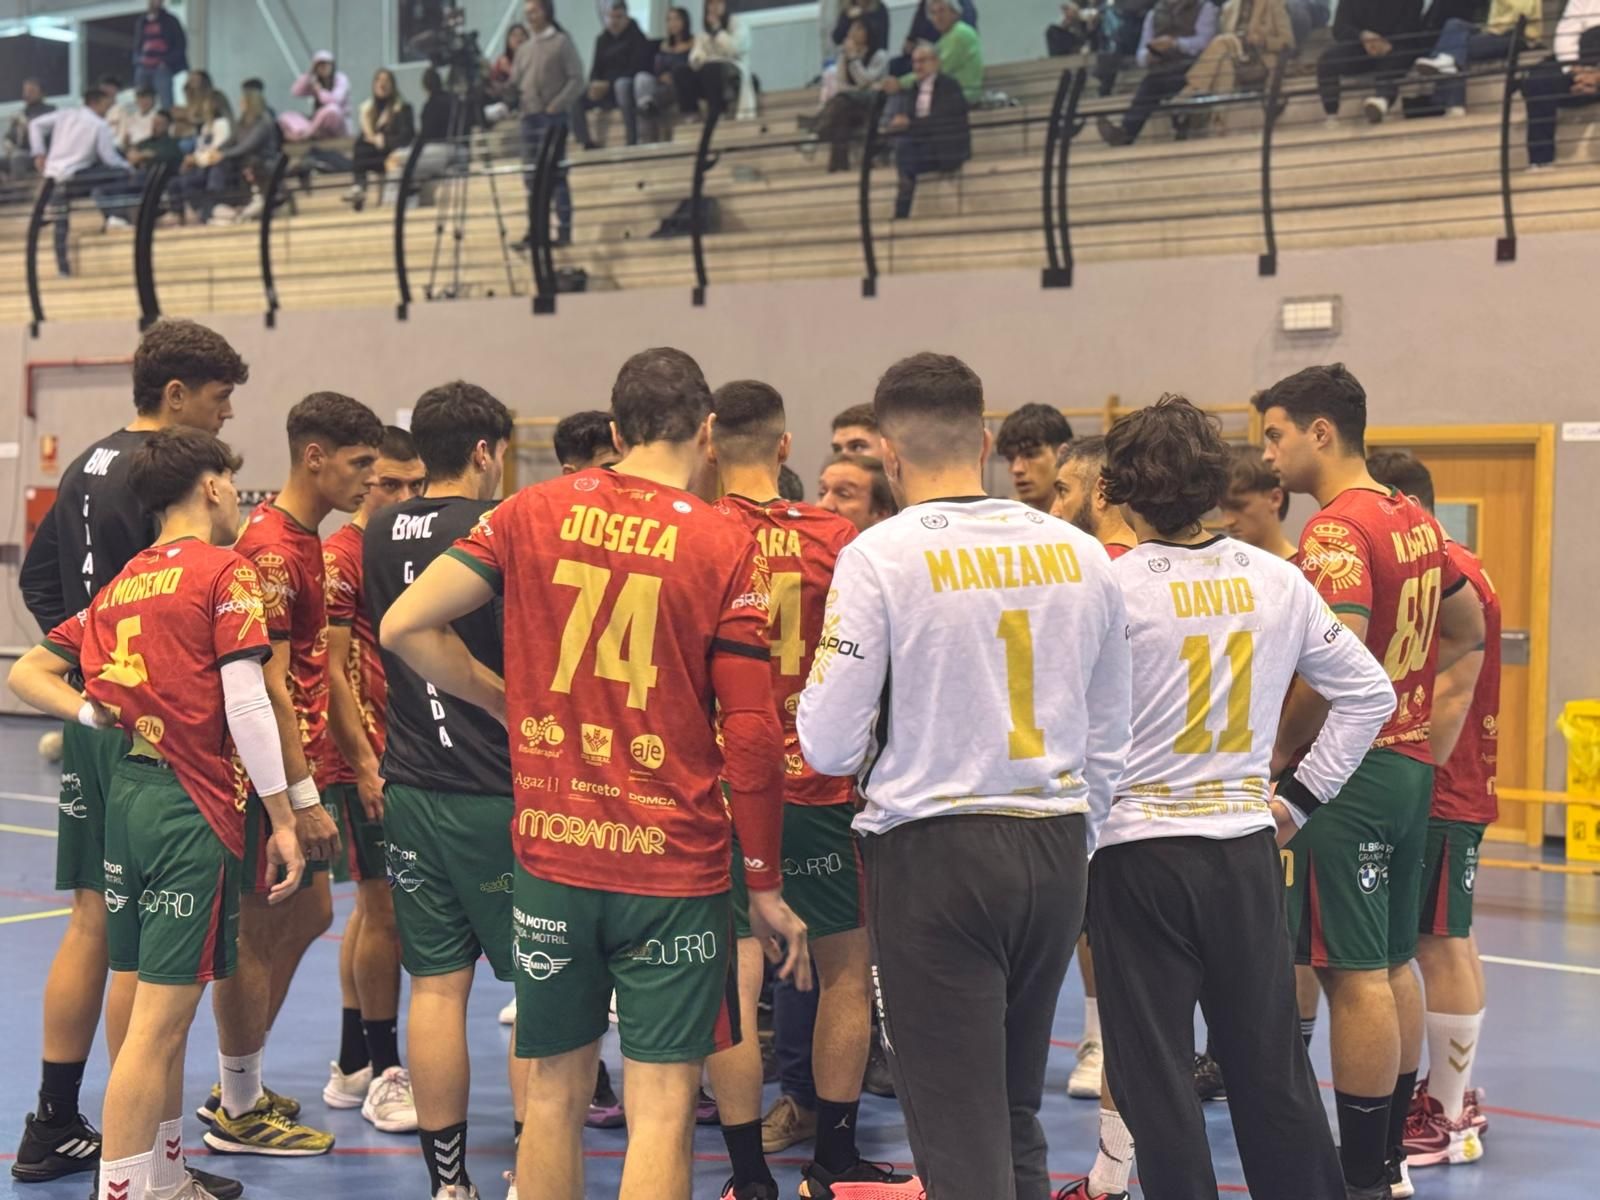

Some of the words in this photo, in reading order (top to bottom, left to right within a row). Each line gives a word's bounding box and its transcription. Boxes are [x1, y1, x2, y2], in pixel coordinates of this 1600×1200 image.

[392, 512, 438, 540] BMC
[559, 504, 679, 561] JOSECA
[924, 543, 1082, 593] MANZANO
[1168, 577, 1255, 618] DAVID
[549, 558, 663, 711] 74
[1382, 567, 1441, 682] 80
[996, 609, 1046, 761] 1
[1172, 630, 1255, 755] 11
[136, 717, 162, 740] aje
[632, 740, 662, 763] aje
[514, 771, 545, 790] Agaz
[570, 777, 621, 797] terceto
[629, 792, 677, 807] DOMCA
[519, 808, 666, 855] MORAMAR
[525, 915, 568, 933] MOTOR
[531, 932, 569, 945] MOTRIL
[646, 931, 717, 965] CURRO
[530, 960, 551, 971] MINI
